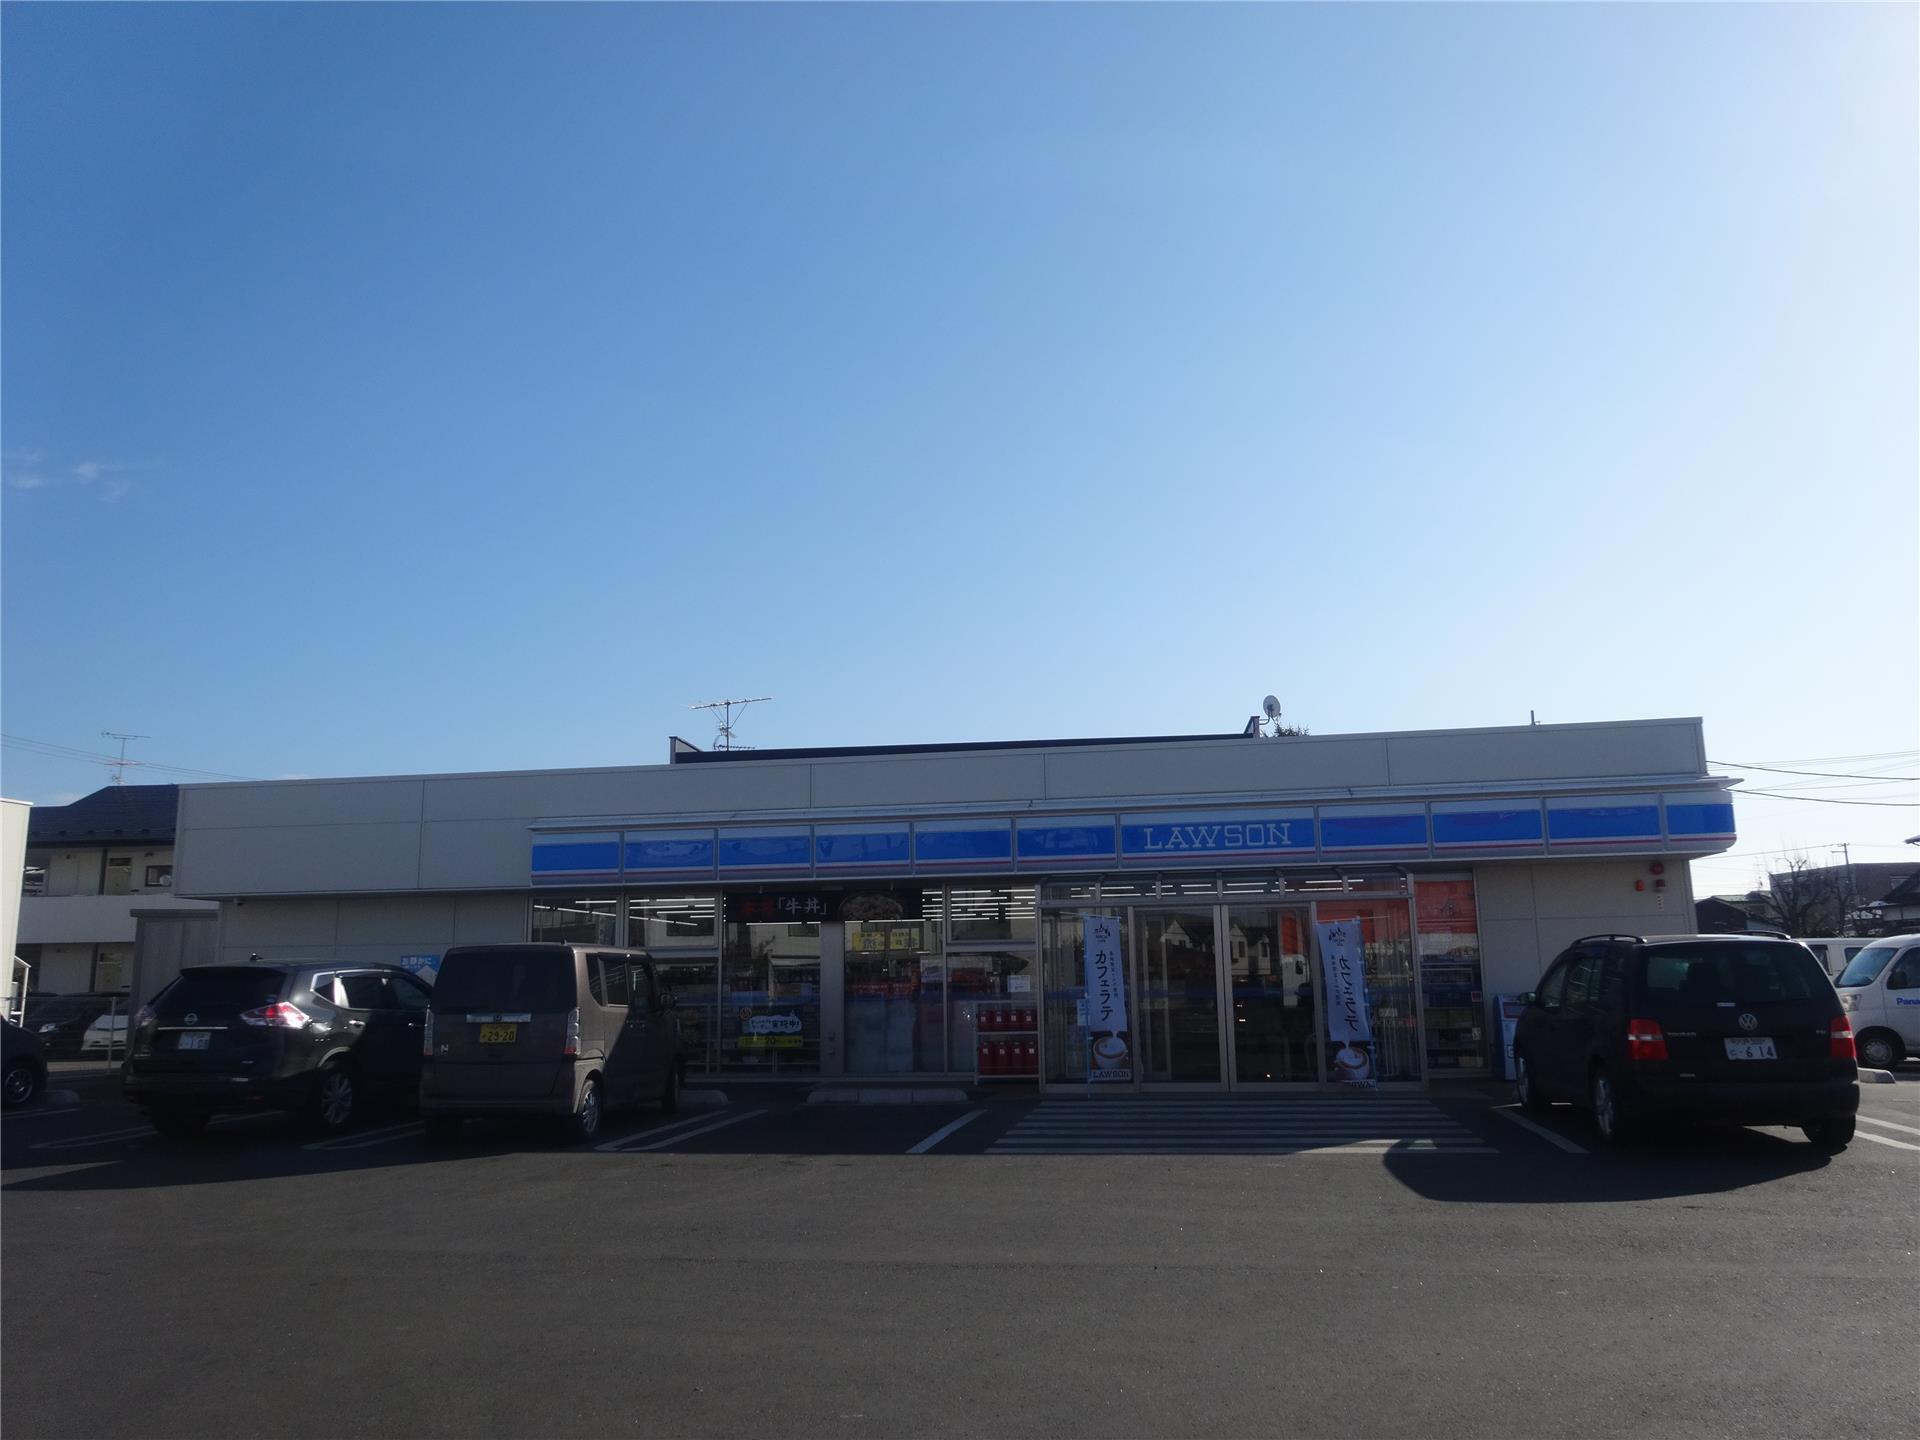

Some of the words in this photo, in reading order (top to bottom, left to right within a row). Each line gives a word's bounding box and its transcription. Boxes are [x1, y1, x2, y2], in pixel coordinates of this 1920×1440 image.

[1143, 822, 1292, 850] LAWSON
[1095, 949, 1113, 1022] カフェラテ
